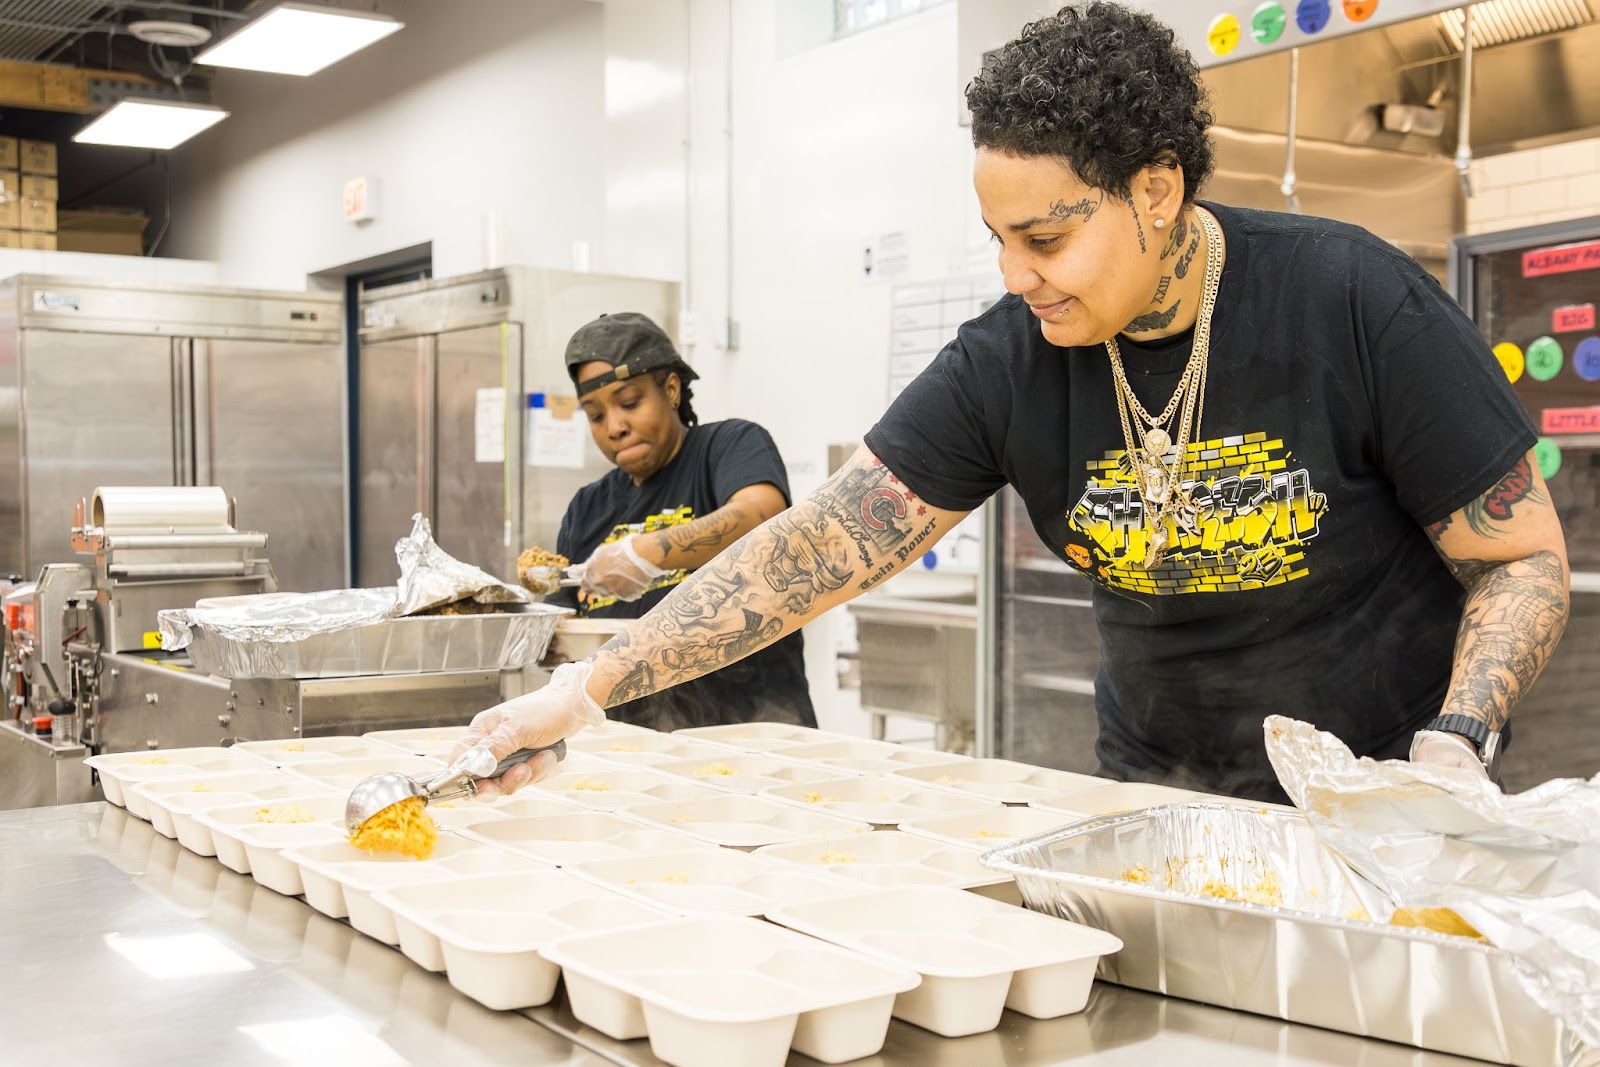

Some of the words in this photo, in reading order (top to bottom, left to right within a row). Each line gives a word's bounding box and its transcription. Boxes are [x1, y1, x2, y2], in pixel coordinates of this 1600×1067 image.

[1049, 198, 1098, 222] Loyalty
[827, 494, 859, 533] World
[858, 562, 895, 590] Twin
[895, 517, 937, 564] Power
